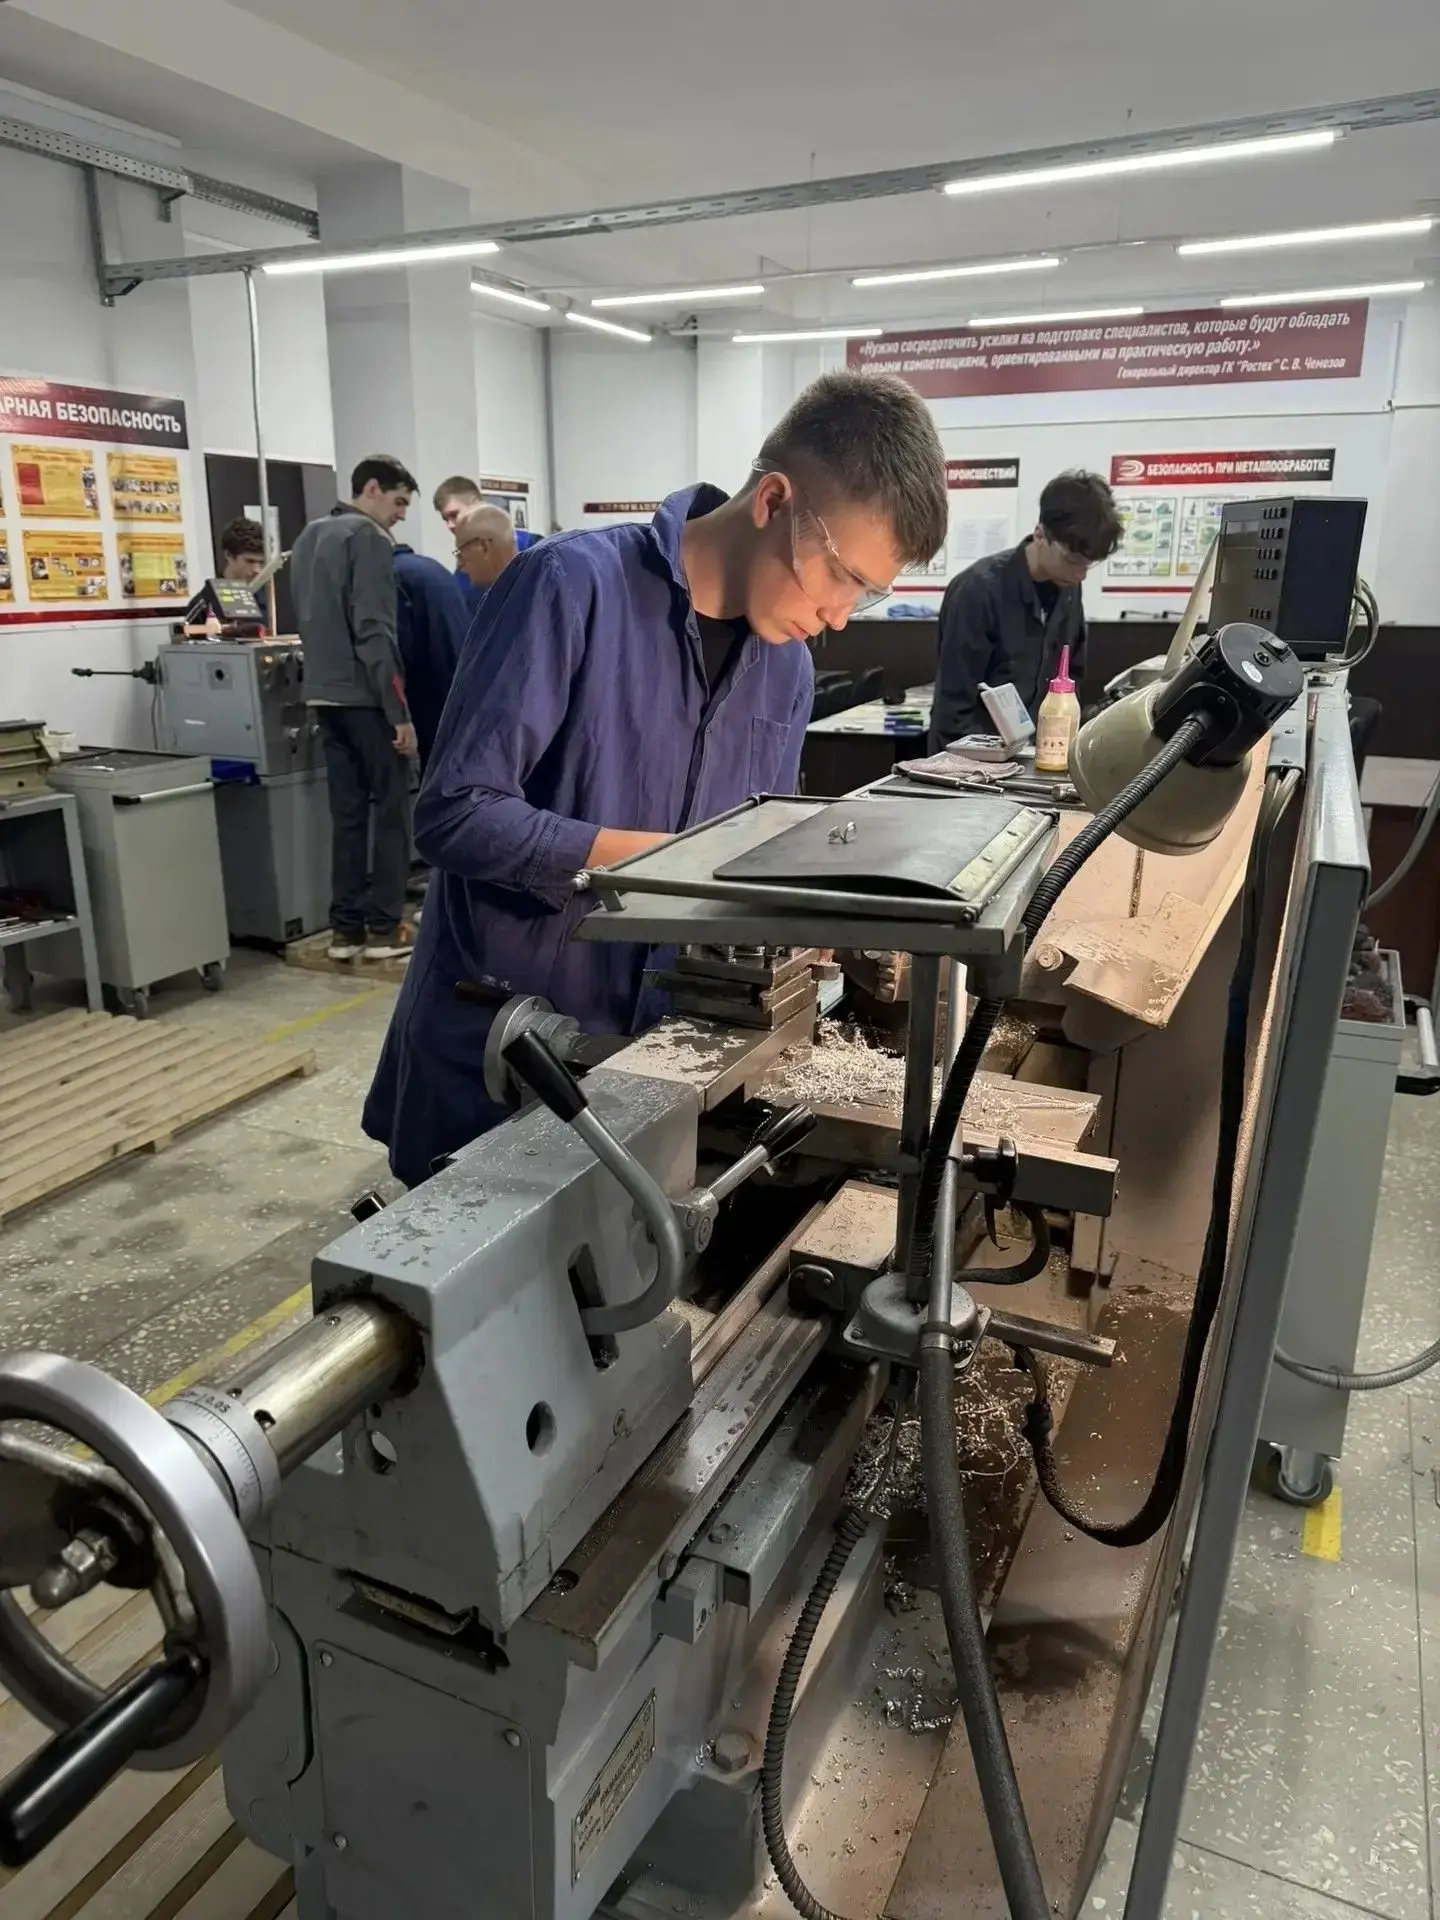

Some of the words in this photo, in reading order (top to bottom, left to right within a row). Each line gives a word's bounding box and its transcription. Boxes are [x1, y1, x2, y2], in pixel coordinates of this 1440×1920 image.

[901, 336, 979, 355] сосредоточить
[979, 334, 1020, 351] усилия
[1020, 332, 1035, 345] на
[1036, 328, 1102, 345] подготовке
[1104, 322, 1190, 341] специалистов,
[1193, 318, 1245, 336] которые
[1249, 314, 1290, 334] будут
[1289, 312, 1350, 329] обладать
[902, 355, 988, 371] компетенциями,
[991, 349, 1100, 369] ориентированными
[1102, 347, 1116, 360] на
[1119, 341, 1205, 361] практическую
[1206, 337, 1260, 357] работу.»
[1117, 364, 1175, 380] Генеральный
[1177, 362, 1220, 377] директор
[1221, 361, 1235, 374] ГК
[1280, 358, 1290, 371] С.
[1291, 357, 1302, 370] В.
[1304, 357, 1346, 370] Чемезов
[56, 401, 182, 433] БЕЗОПАСНОСТЬ
[947, 465, 1017, 481] ПРОИСШЕСТВИЙ
[1146, 461, 1214, 477] БЕЗОПАСНОСТЬ
[1215, 461, 1234, 474] ПРИ
[1235, 458, 1331, 473] МЕТАЛЛООБРАБОТКЕ
